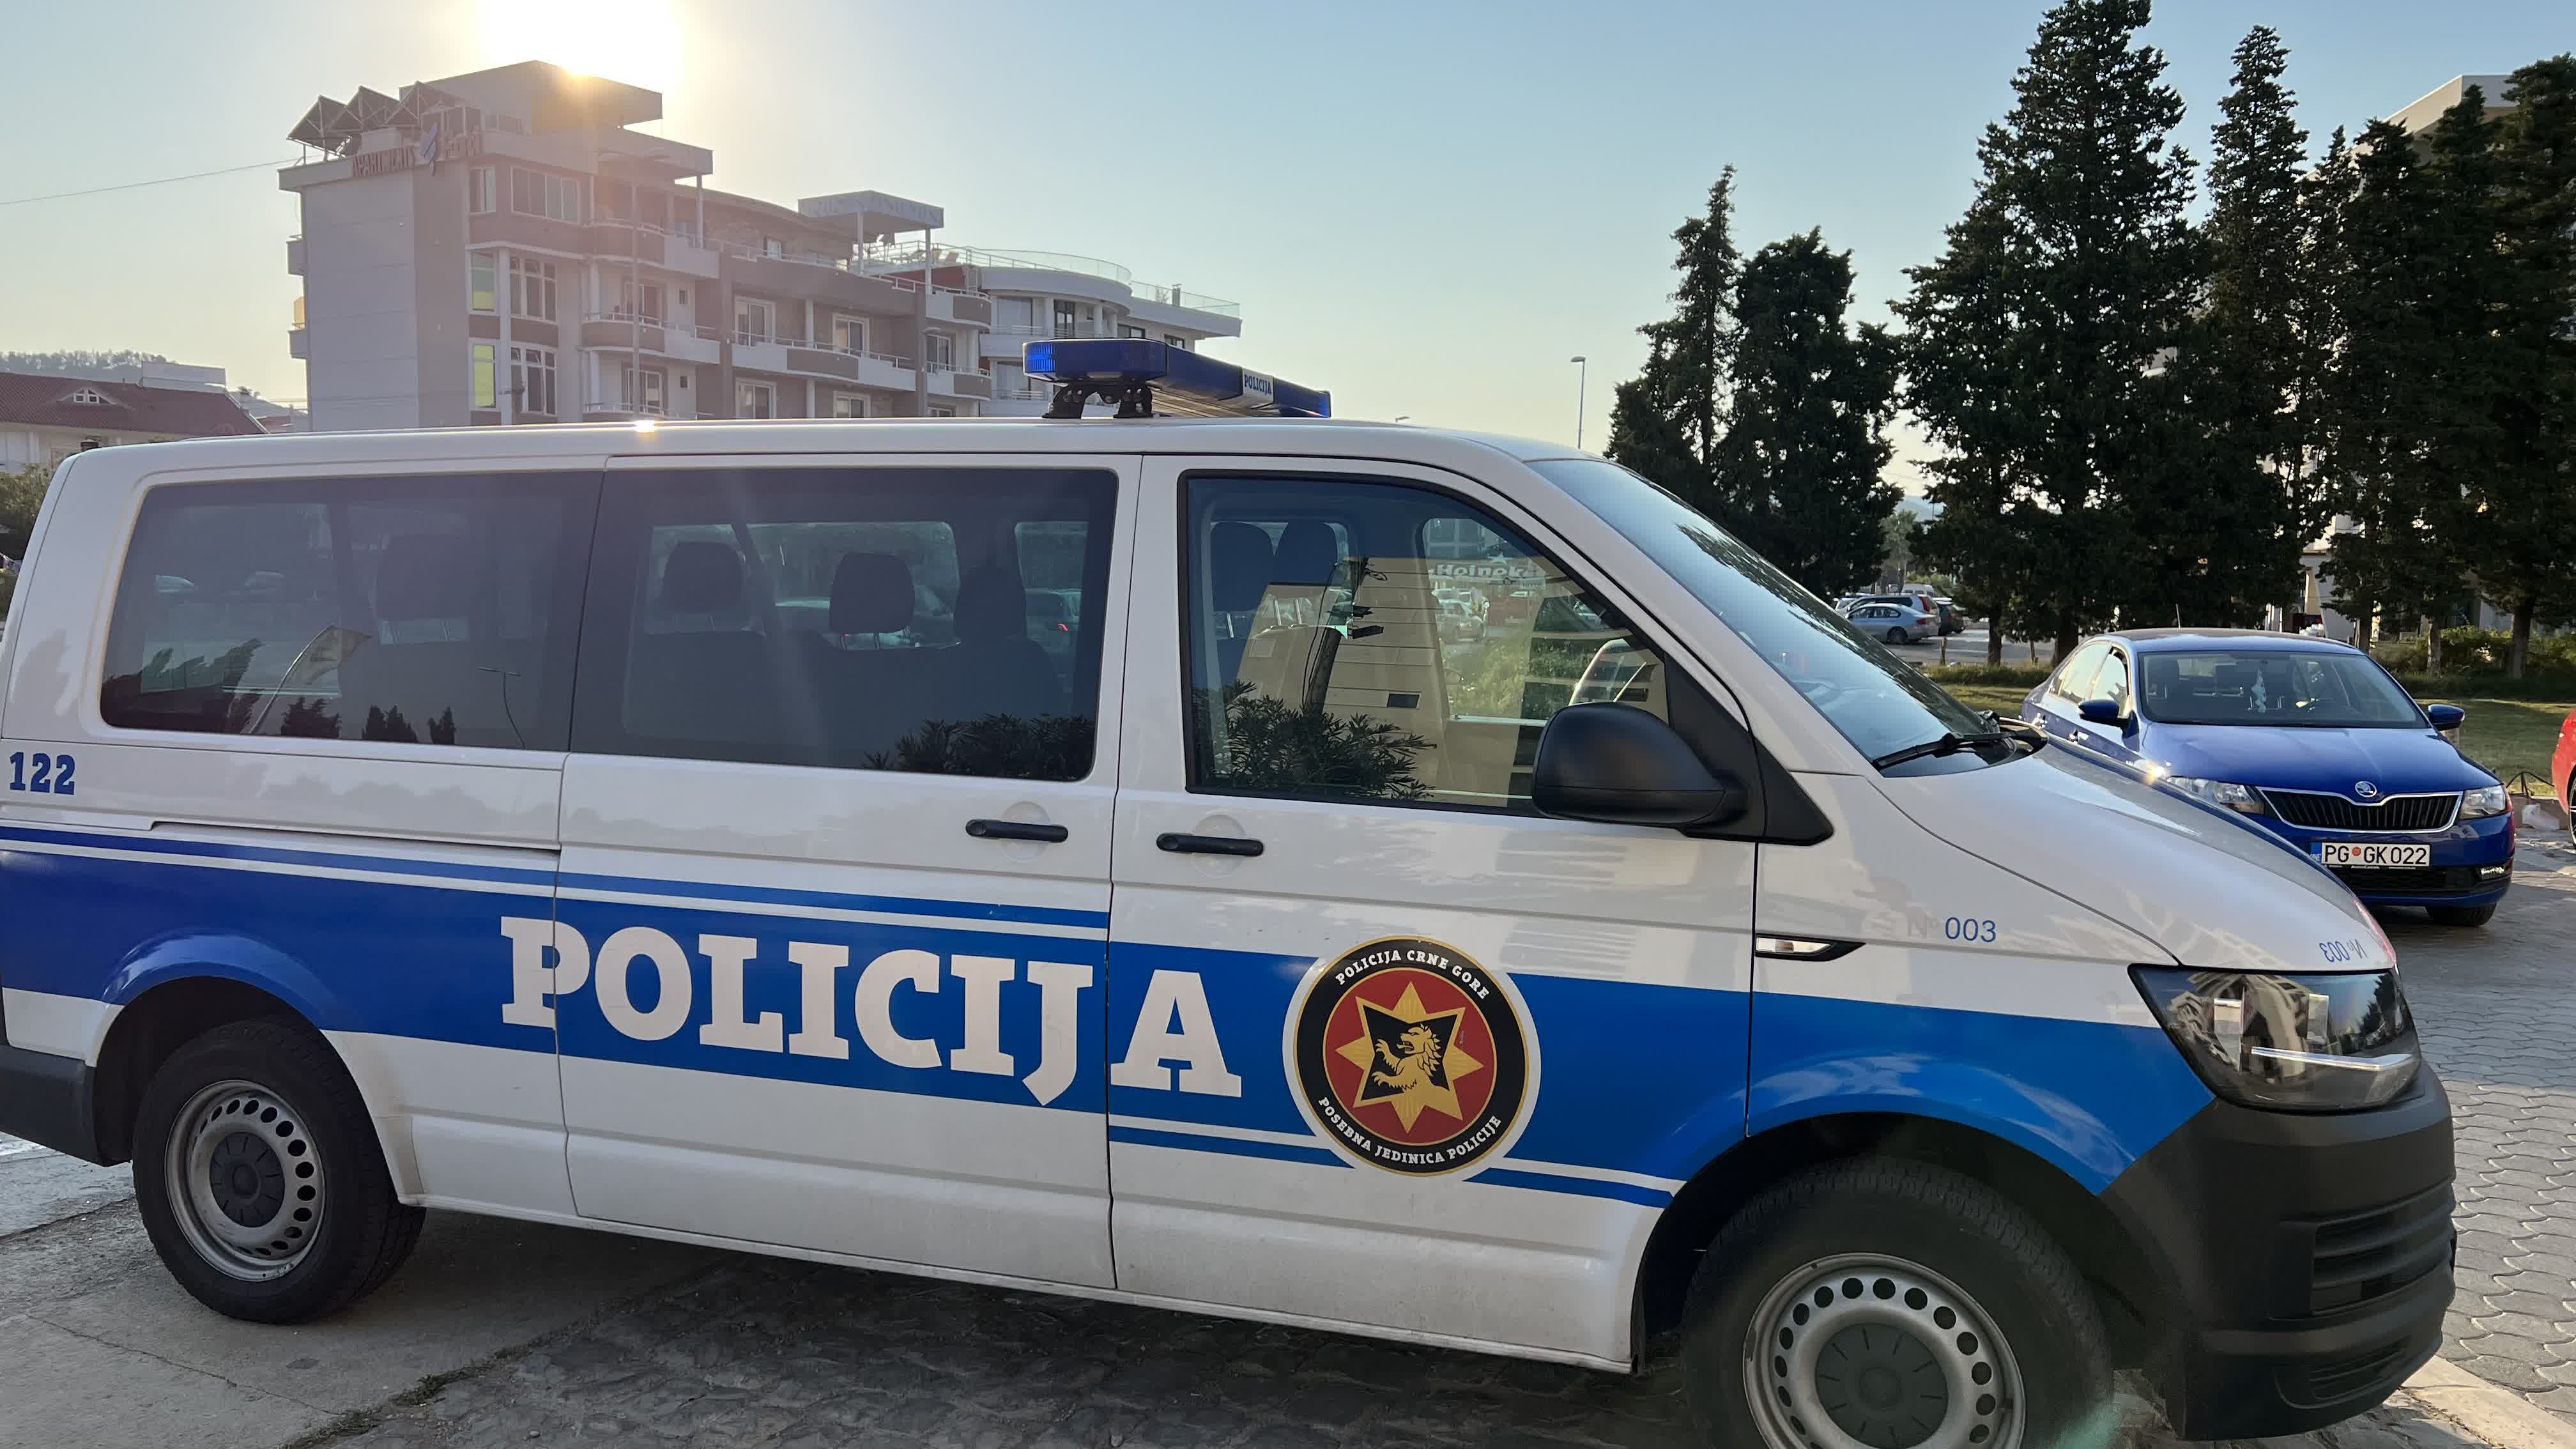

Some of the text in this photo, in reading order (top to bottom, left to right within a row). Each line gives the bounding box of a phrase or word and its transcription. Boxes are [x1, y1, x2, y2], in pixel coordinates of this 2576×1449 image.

[1245, 374, 1271, 395] POLICIJA
[1437, 564, 1546, 578] Heinek
[10, 752, 75, 795] 122
[2325, 845, 2349, 862] PG
[1945, 917, 1997, 942] 003
[1335, 949, 1489, 1000] POLICIJA CRNE GORE
[500, 916, 1242, 1106] POLICIJA
[1318, 1096, 1502, 1165] POSEBNA JEDINICA POLICIJE
